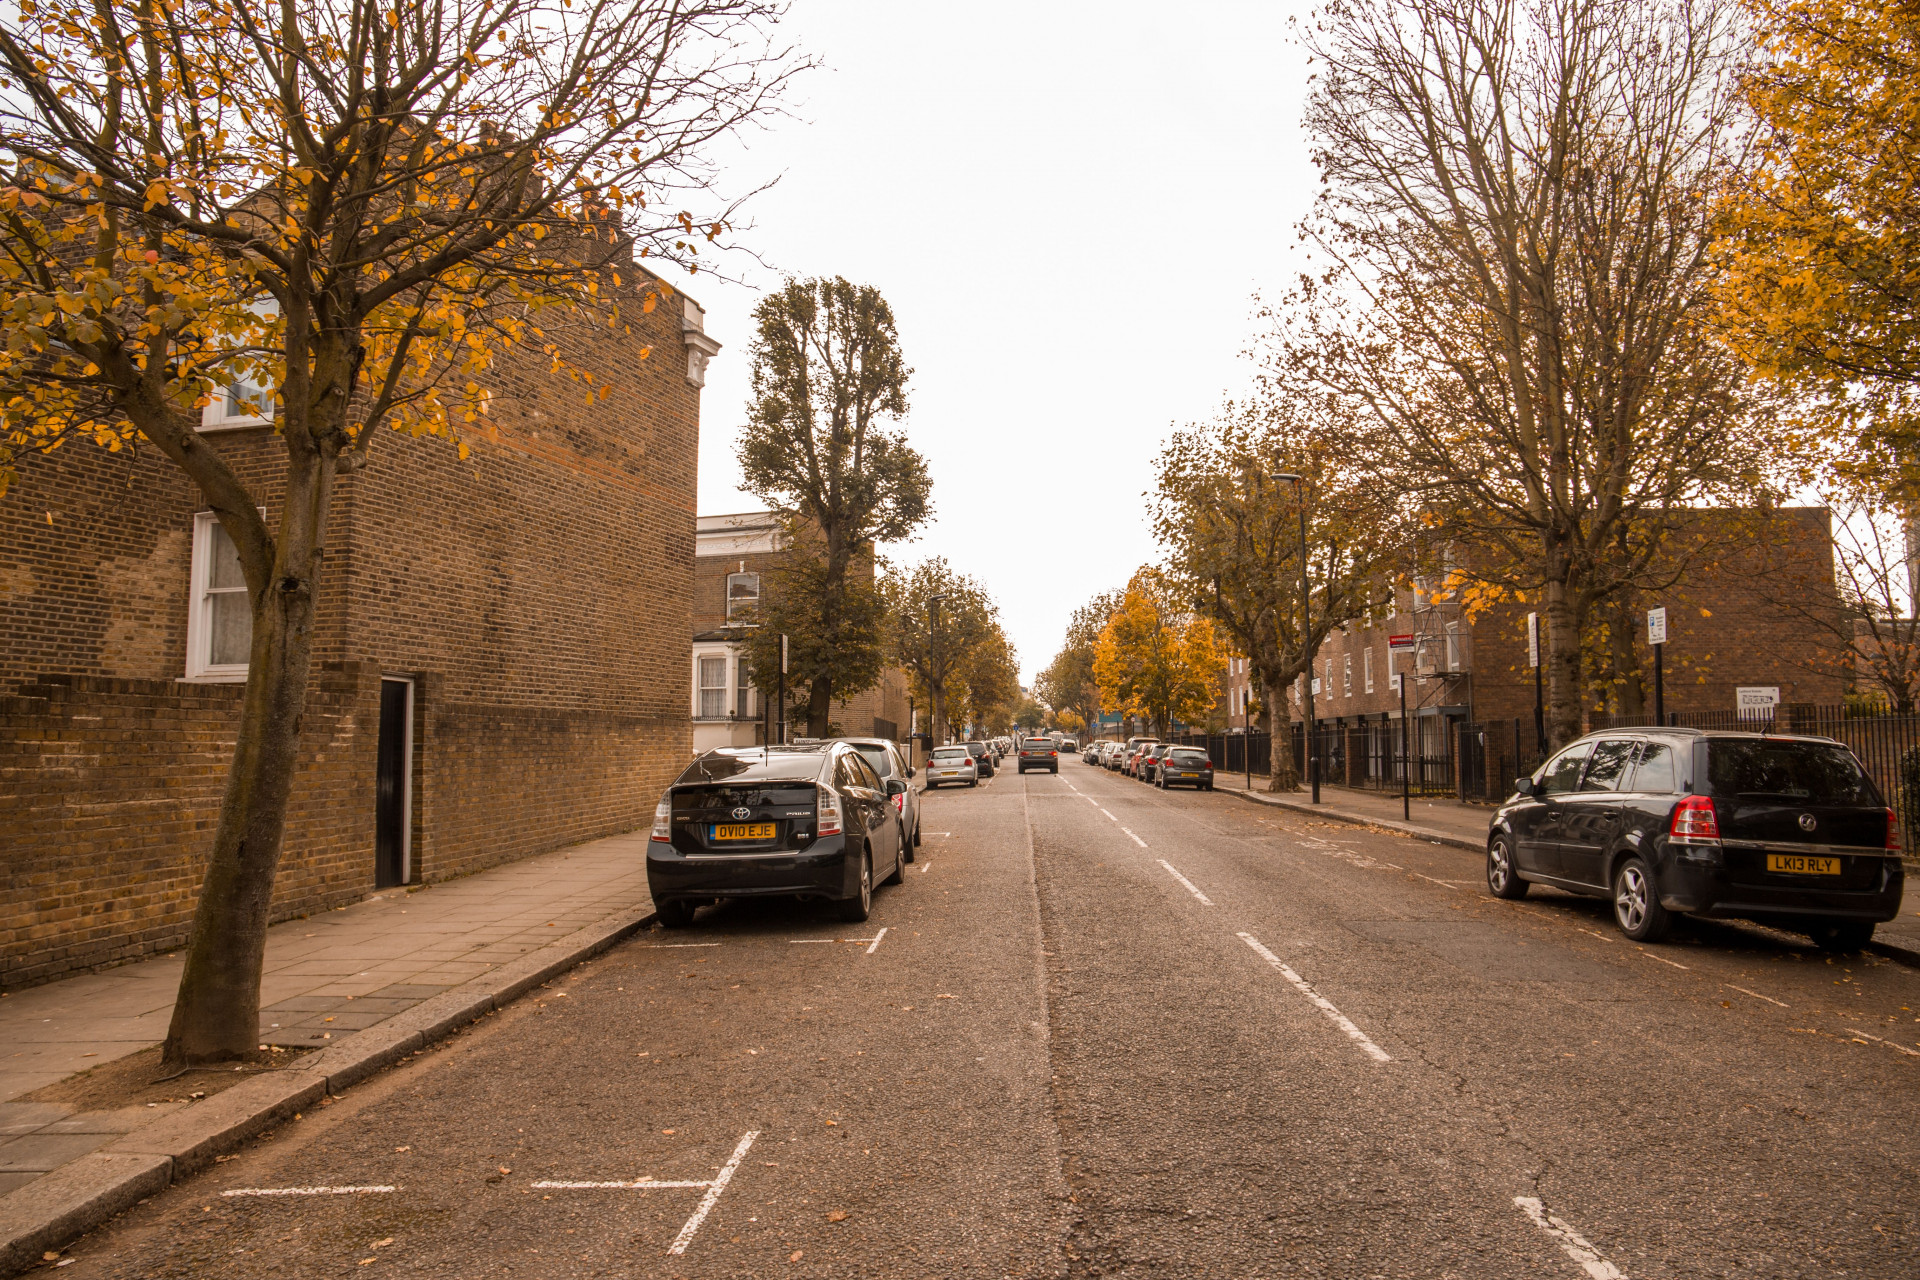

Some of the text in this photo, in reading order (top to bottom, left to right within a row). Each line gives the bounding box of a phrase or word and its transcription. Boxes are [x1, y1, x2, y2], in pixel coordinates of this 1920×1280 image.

[720, 825, 771, 837] OV10 EJE
[1775, 857, 1832, 872] LK13 RLY
